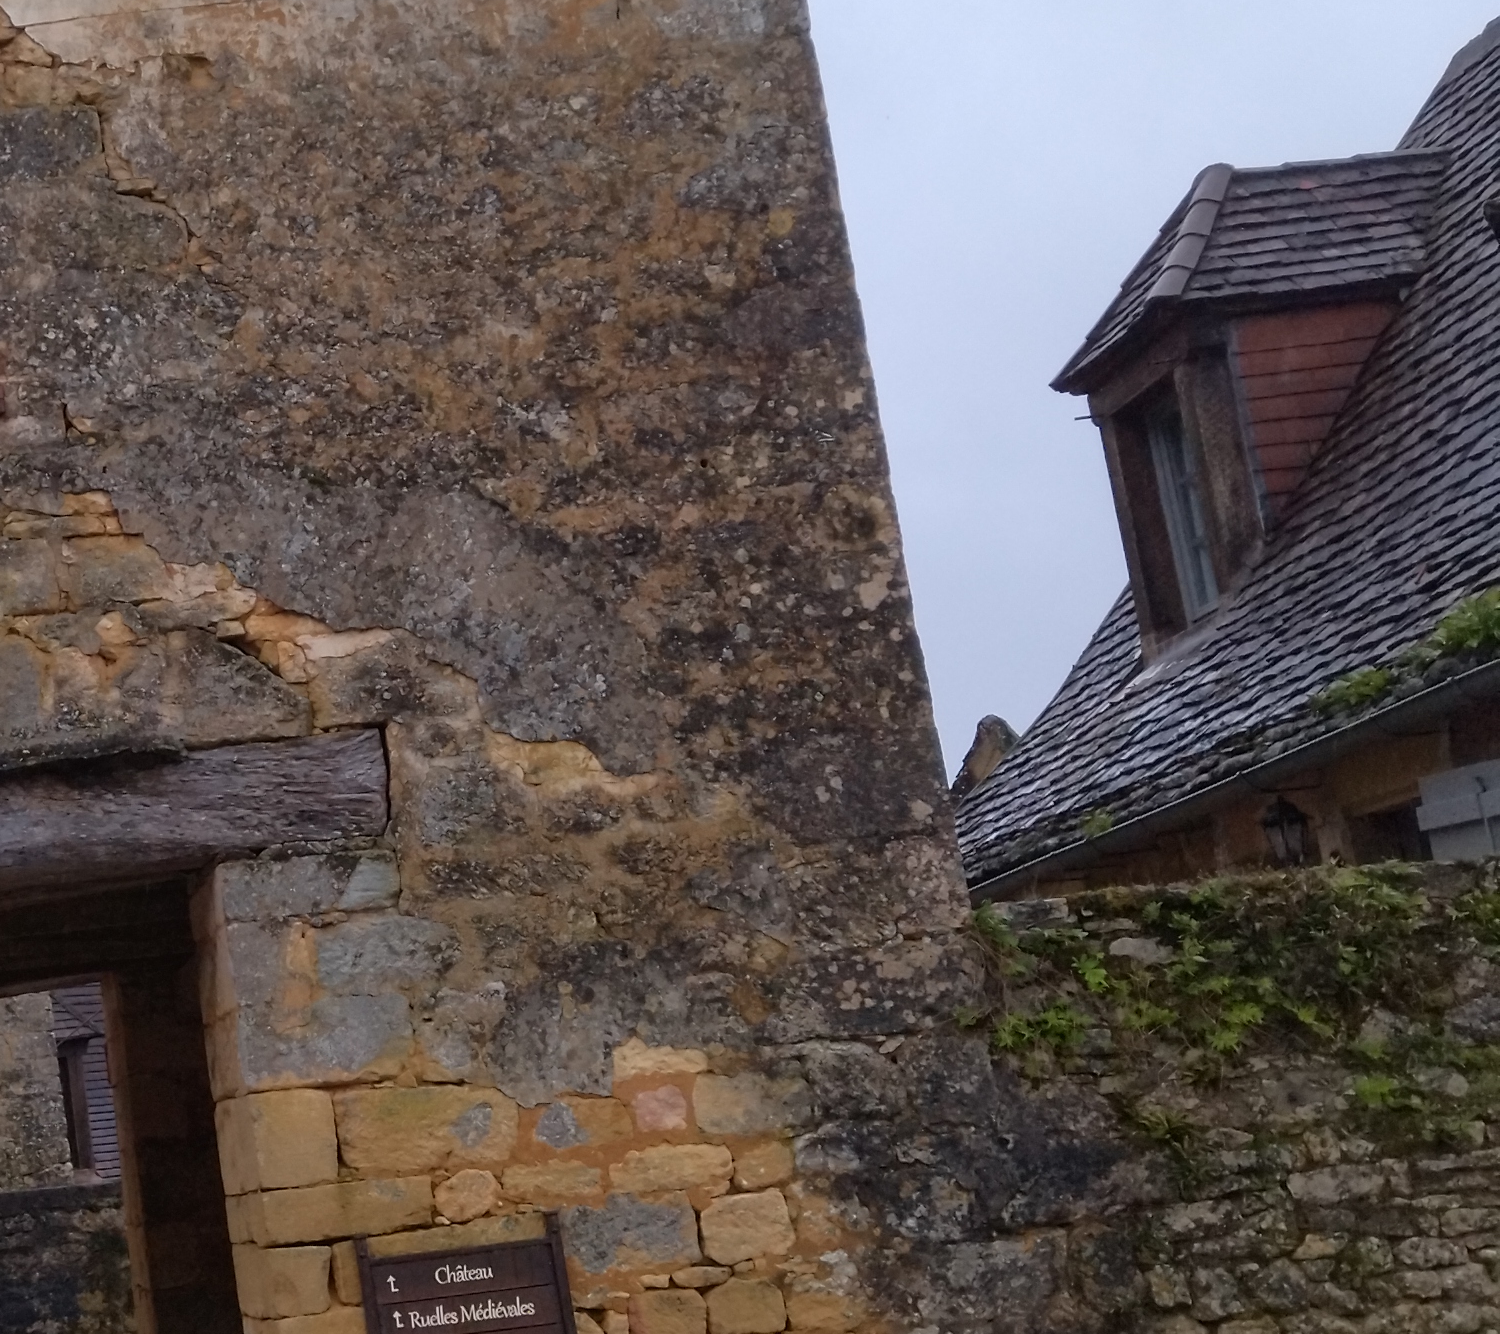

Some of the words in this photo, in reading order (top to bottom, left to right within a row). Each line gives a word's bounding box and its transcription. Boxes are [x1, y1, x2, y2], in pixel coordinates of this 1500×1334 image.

[434, 1264, 493, 1285] Château
[408, 1304, 459, 1329] Ruelles
[460, 1295, 536, 1323] Médiévales
